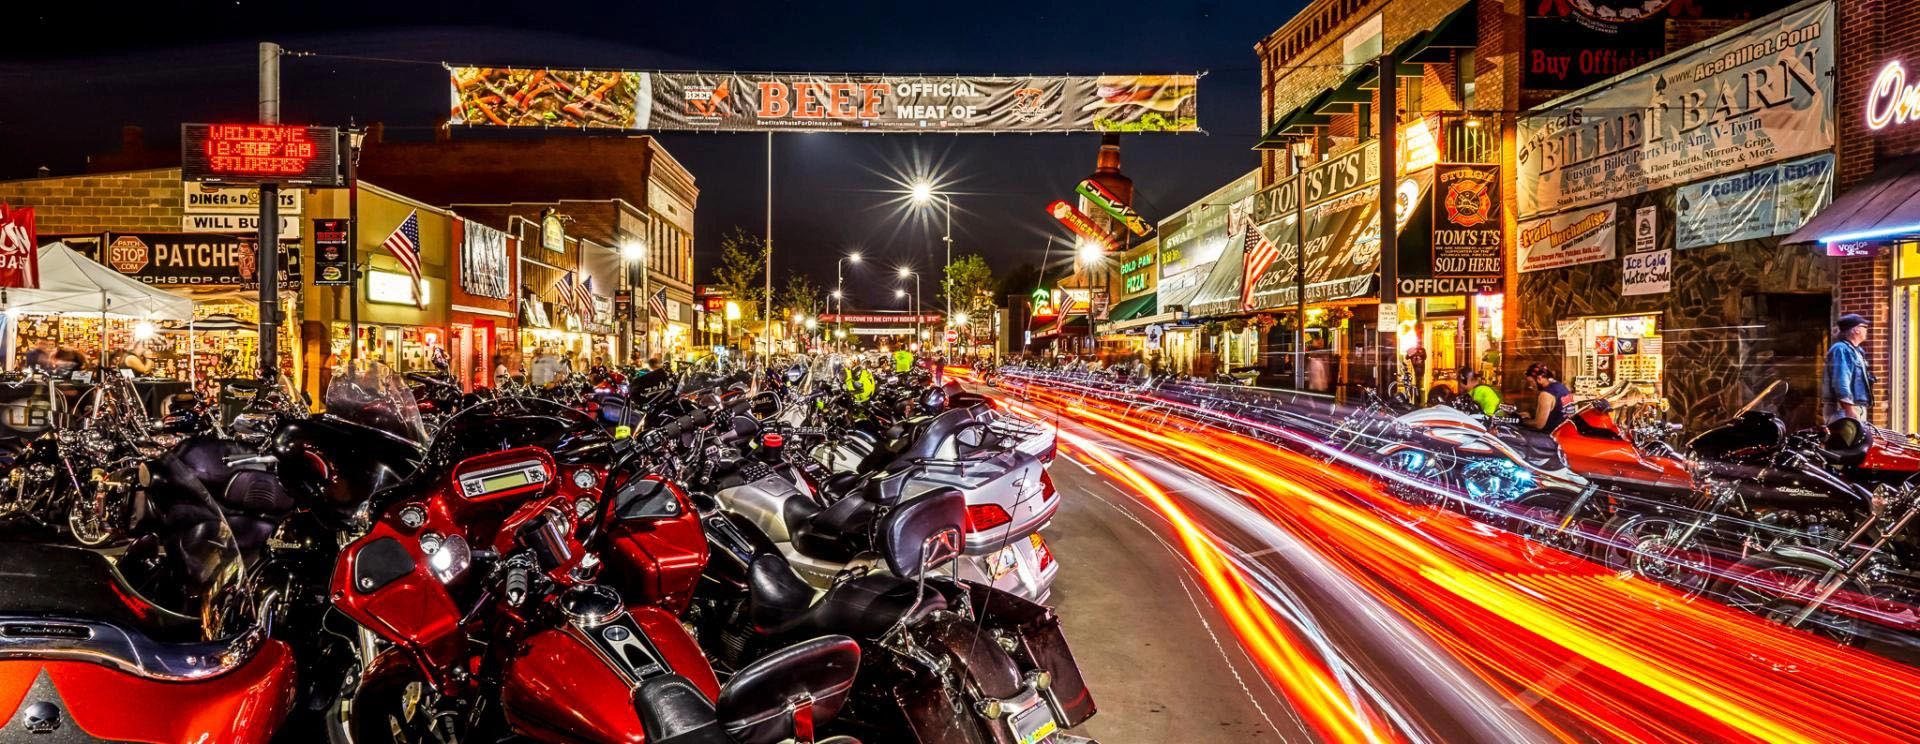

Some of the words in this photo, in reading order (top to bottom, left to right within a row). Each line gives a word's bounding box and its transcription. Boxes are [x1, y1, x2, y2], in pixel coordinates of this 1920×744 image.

[1694, 21, 1821, 83] AceBillet.Com
[1531, 49, 1570, 80] Buy
[685, 91, 713, 100] BEEF
[757, 81, 892, 119] BEEF
[897, 83, 979, 97] OFFICIAL
[897, 106, 943, 119] MEAT
[951, 107, 978, 119] OF
[1539, 100, 1669, 176] BILLET
[1679, 47, 1819, 135] BARN
[1566, 165, 1601, 182] Custom
[1604, 156, 1631, 171] Billet
[1633, 147, 1661, 165] Parts
[1663, 141, 1684, 154] For
[1688, 134, 1711, 148] Am.
[1714, 117, 1762, 139] V-Twin
[1650, 163, 1671, 173] Floor
[1672, 153, 1703, 166] Boards,
[1705, 146, 1742, 159] Mirrors,
[1744, 136, 1772, 150] Grips
[1715, 156, 1735, 168] Pegs
[1738, 153, 1746, 163] &
[1749, 146, 1778, 160] More.
[1327, 152, 1361, 195] T'S
[1440, 169, 1495, 183] STURGIS
[190, 194, 228, 205] DINER
[194, 218, 233, 229] WILL
[1520, 218, 1552, 248] Event
[1550, 209, 1609, 249] Merchandise
[1435, 229, 1478, 246] TOM'S
[1480, 229, 1501, 246] T'S
[113, 248, 145, 262] STOP
[155, 244, 240, 267] PATCHE
[1435, 257, 1466, 273] SOLD
[1468, 257, 1501, 272] HERE
[1625, 257, 1642, 270] Ice
[1645, 253, 1668, 268] Cold
[1120, 262, 1137, 275] GOLD
[1126, 273, 1145, 293] PIZZA
[1401, 278, 1478, 294] OFFICIAL
